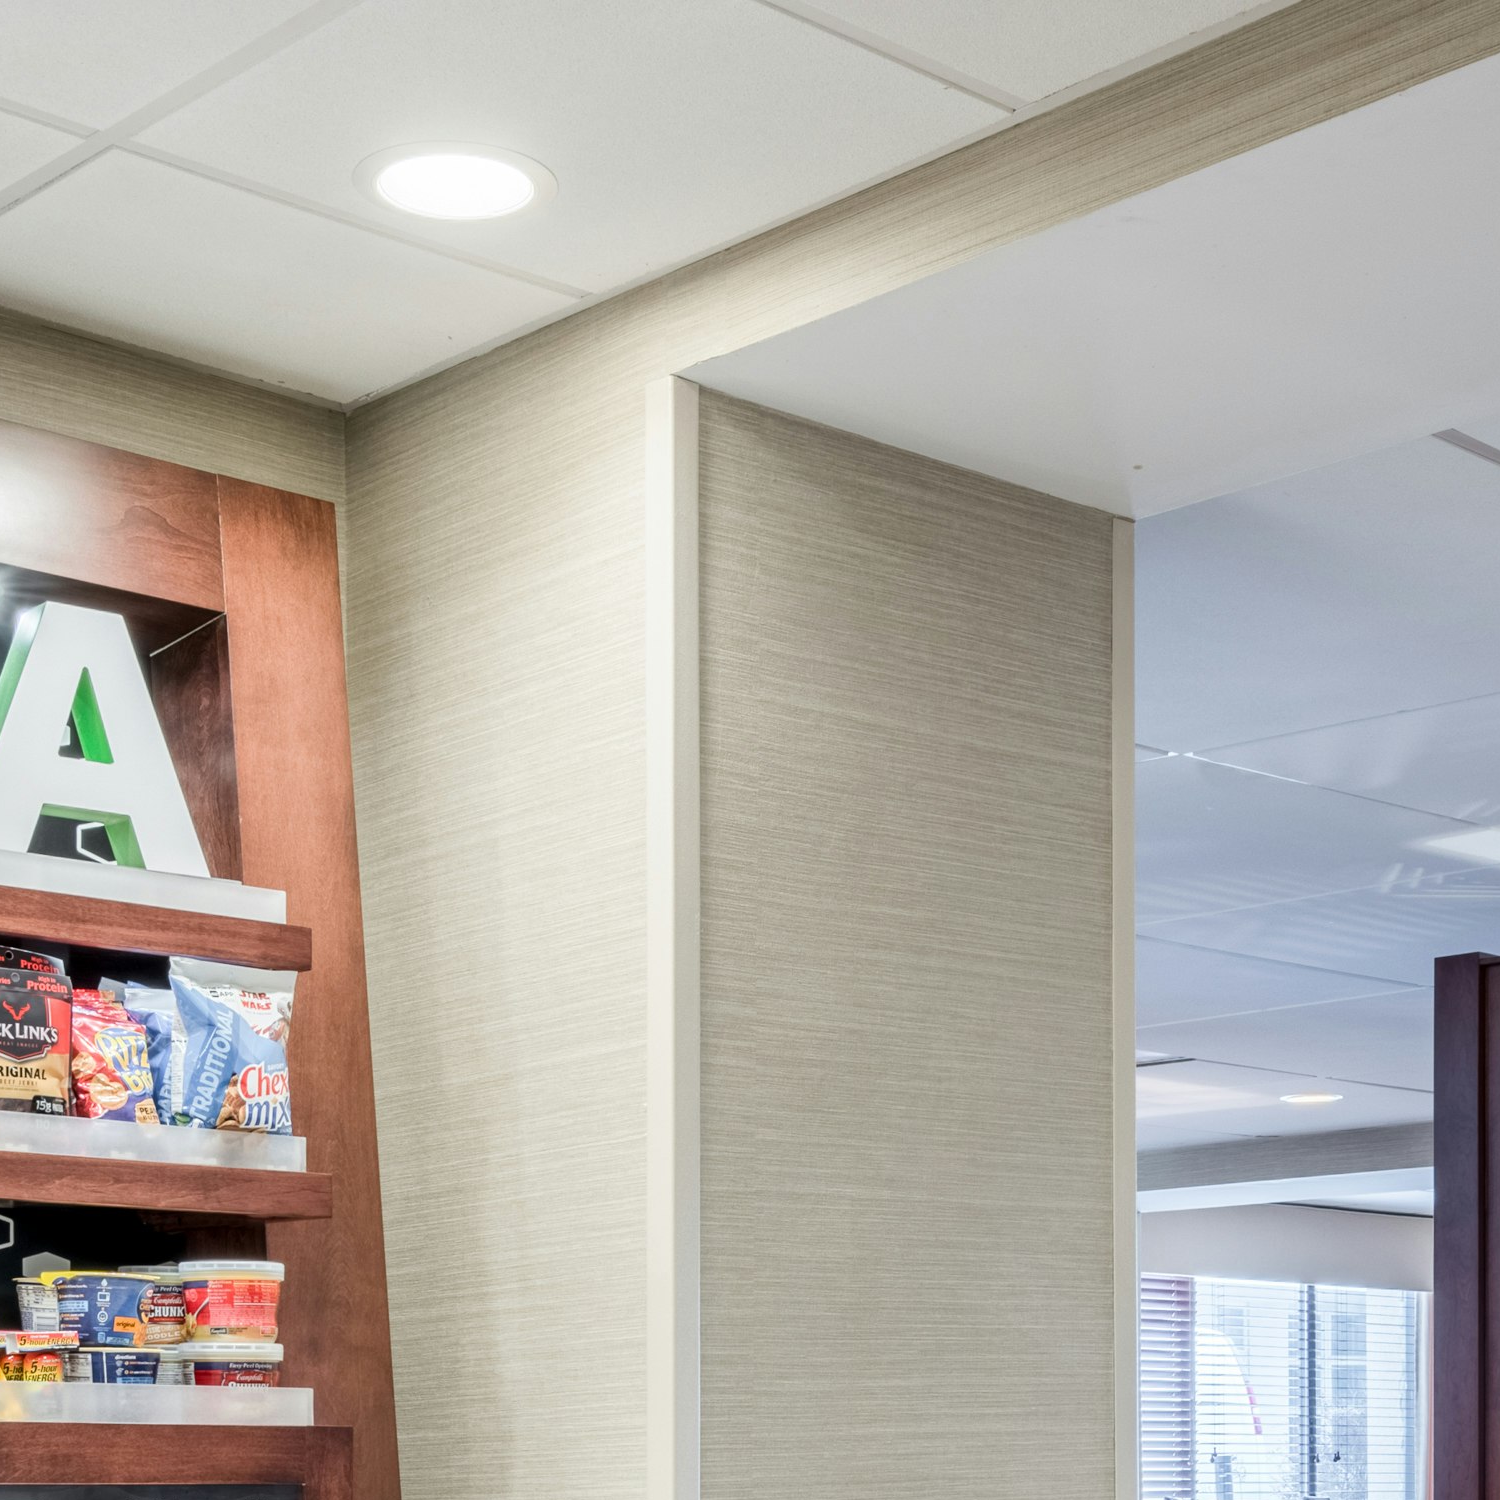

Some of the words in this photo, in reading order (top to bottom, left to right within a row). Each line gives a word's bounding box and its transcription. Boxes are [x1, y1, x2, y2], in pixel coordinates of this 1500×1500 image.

[20, 959, 61, 974] Protein
[26, 980, 68, 993] Protein
[241, 1000, 272, 1011] WARS
[189, 1010, 234, 1124] TRADITIONAL
[240, 1062, 289, 1099] Chex
[35, 1099, 52, 1113] 15g
[147, 1305, 185, 1318] CHUNK
[115, 1321, 136, 1329] original
[46, 1336, 75, 1346] ENERGY
[145, 1332, 181, 1340] OODLE
[30, 1361, 58, 1374] 5-hour
